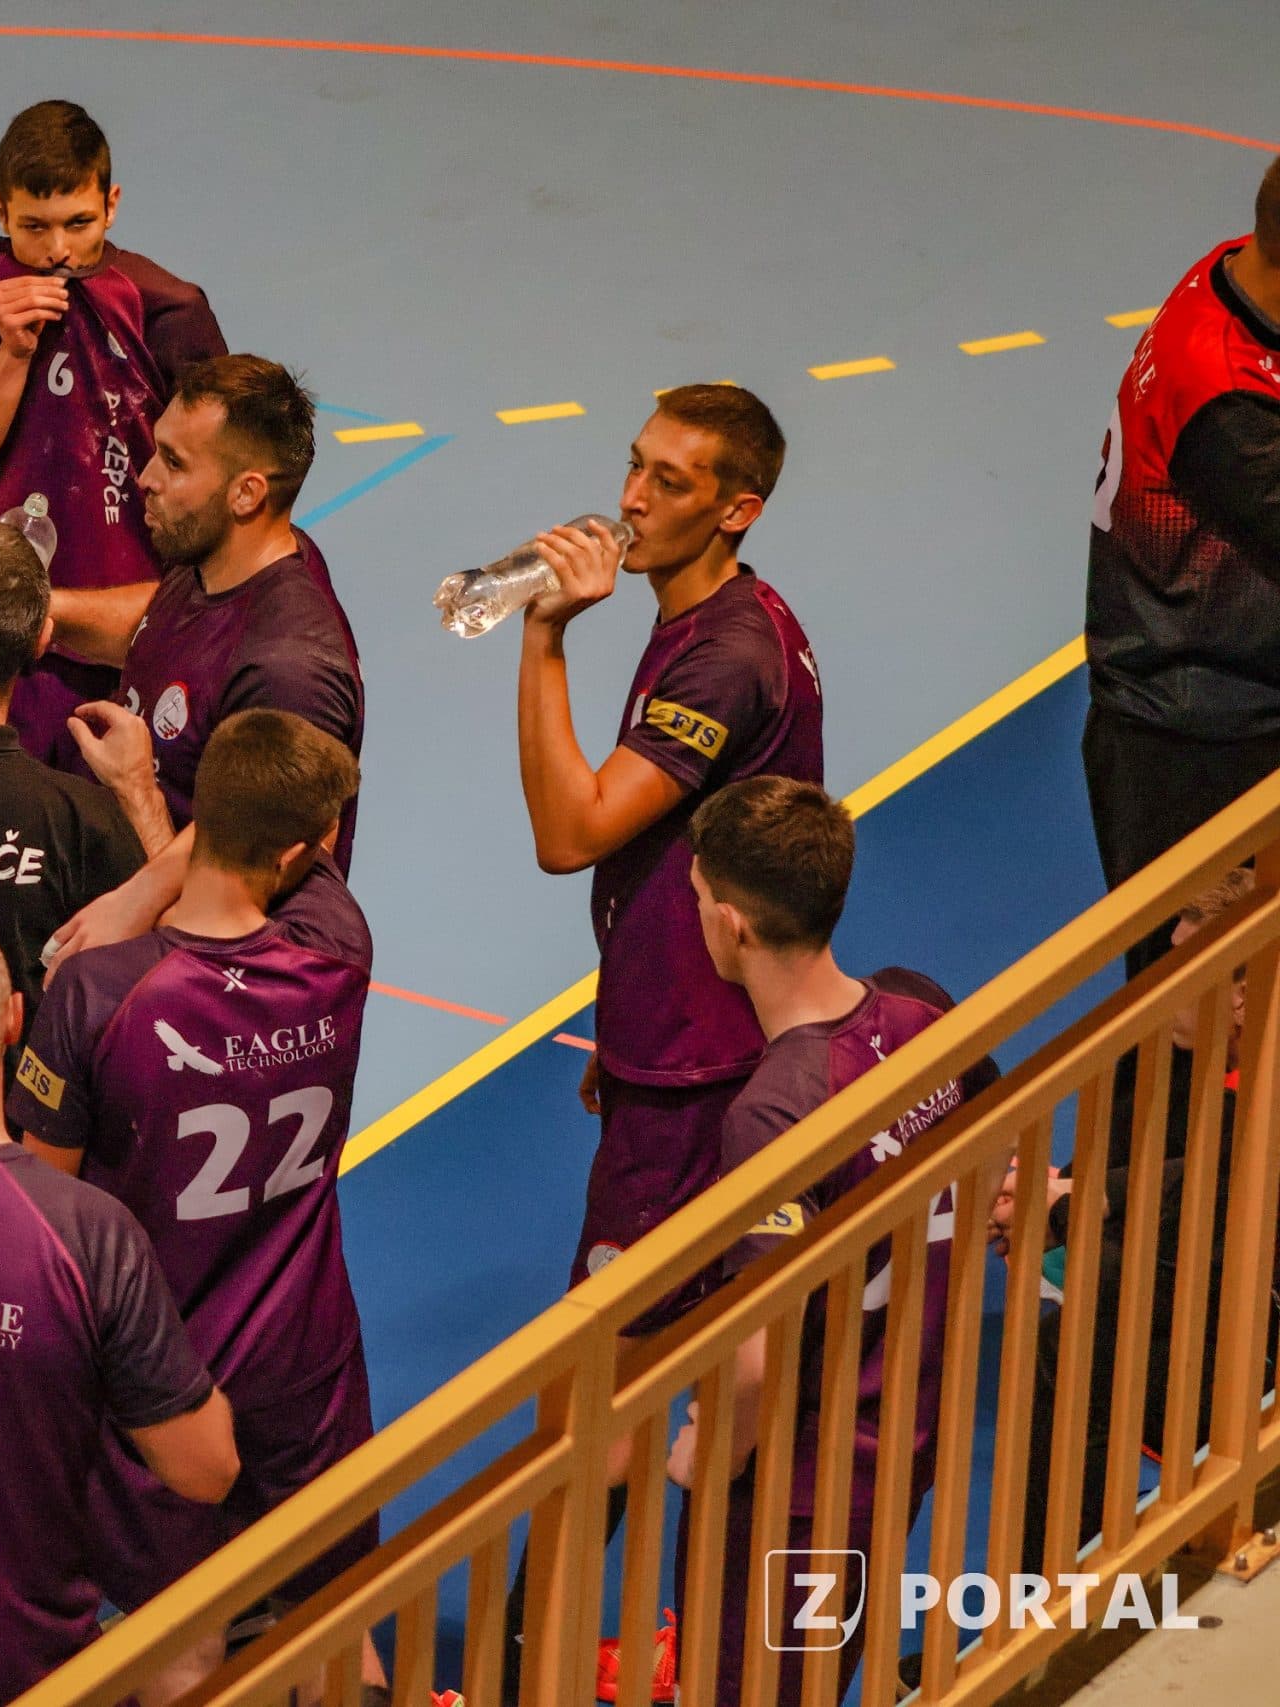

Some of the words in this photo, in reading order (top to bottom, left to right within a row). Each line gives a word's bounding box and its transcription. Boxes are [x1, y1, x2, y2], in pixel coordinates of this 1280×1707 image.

[48, 352, 74, 396] 6
[670, 711, 719, 748] FIS
[224, 1015, 335, 1058] EAGLE
[225, 1037, 336, 1072] TECHNOLOGY
[19, 1055, 51, 1096] FIS
[176, 1086, 334, 1221] 22
